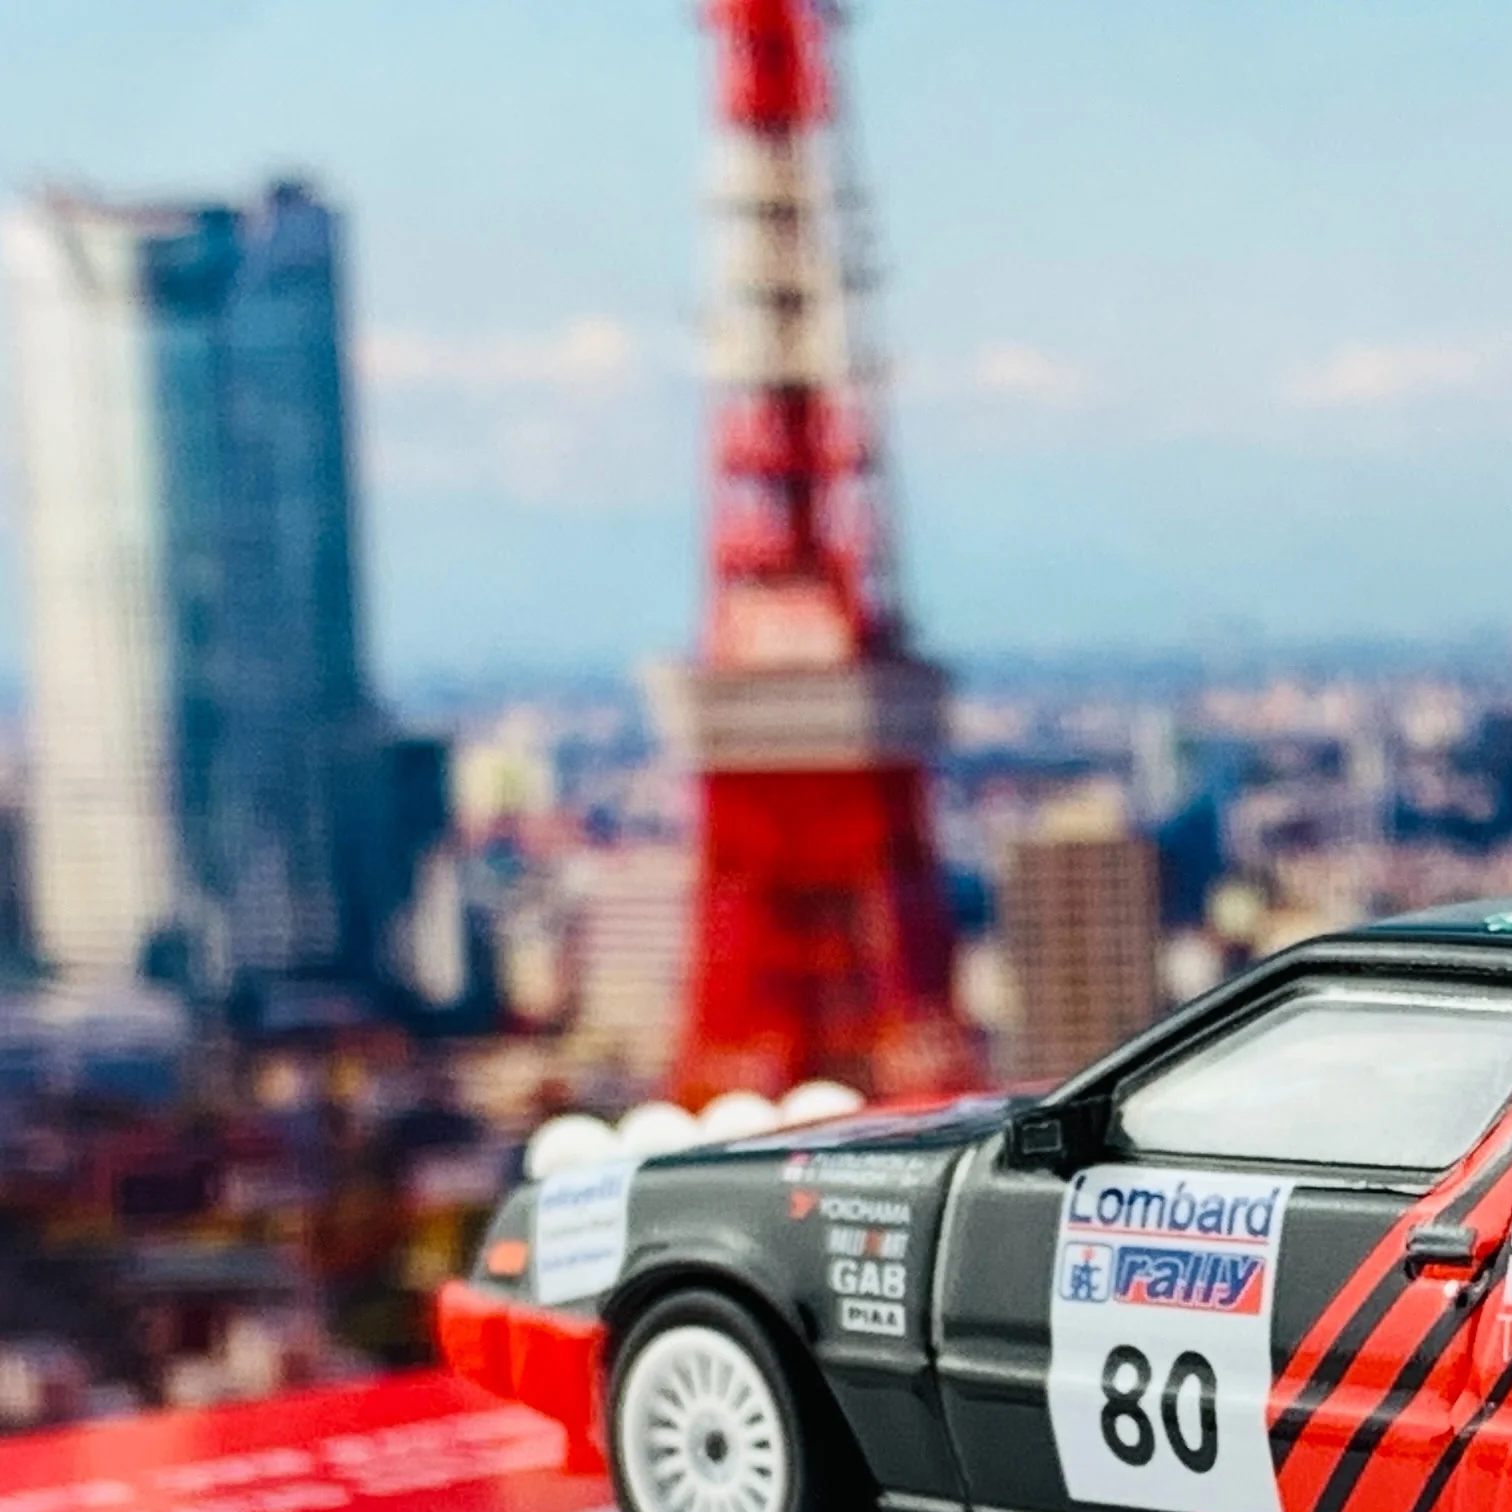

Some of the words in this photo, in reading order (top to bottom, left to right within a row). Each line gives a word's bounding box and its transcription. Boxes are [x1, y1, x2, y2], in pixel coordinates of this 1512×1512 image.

[1069, 1174, 1281, 1238] Lombard
[831, 1258, 906, 1299] GAB
[1115, 1250, 1267, 1311] rally
[1101, 1344, 1218, 1474] 80
